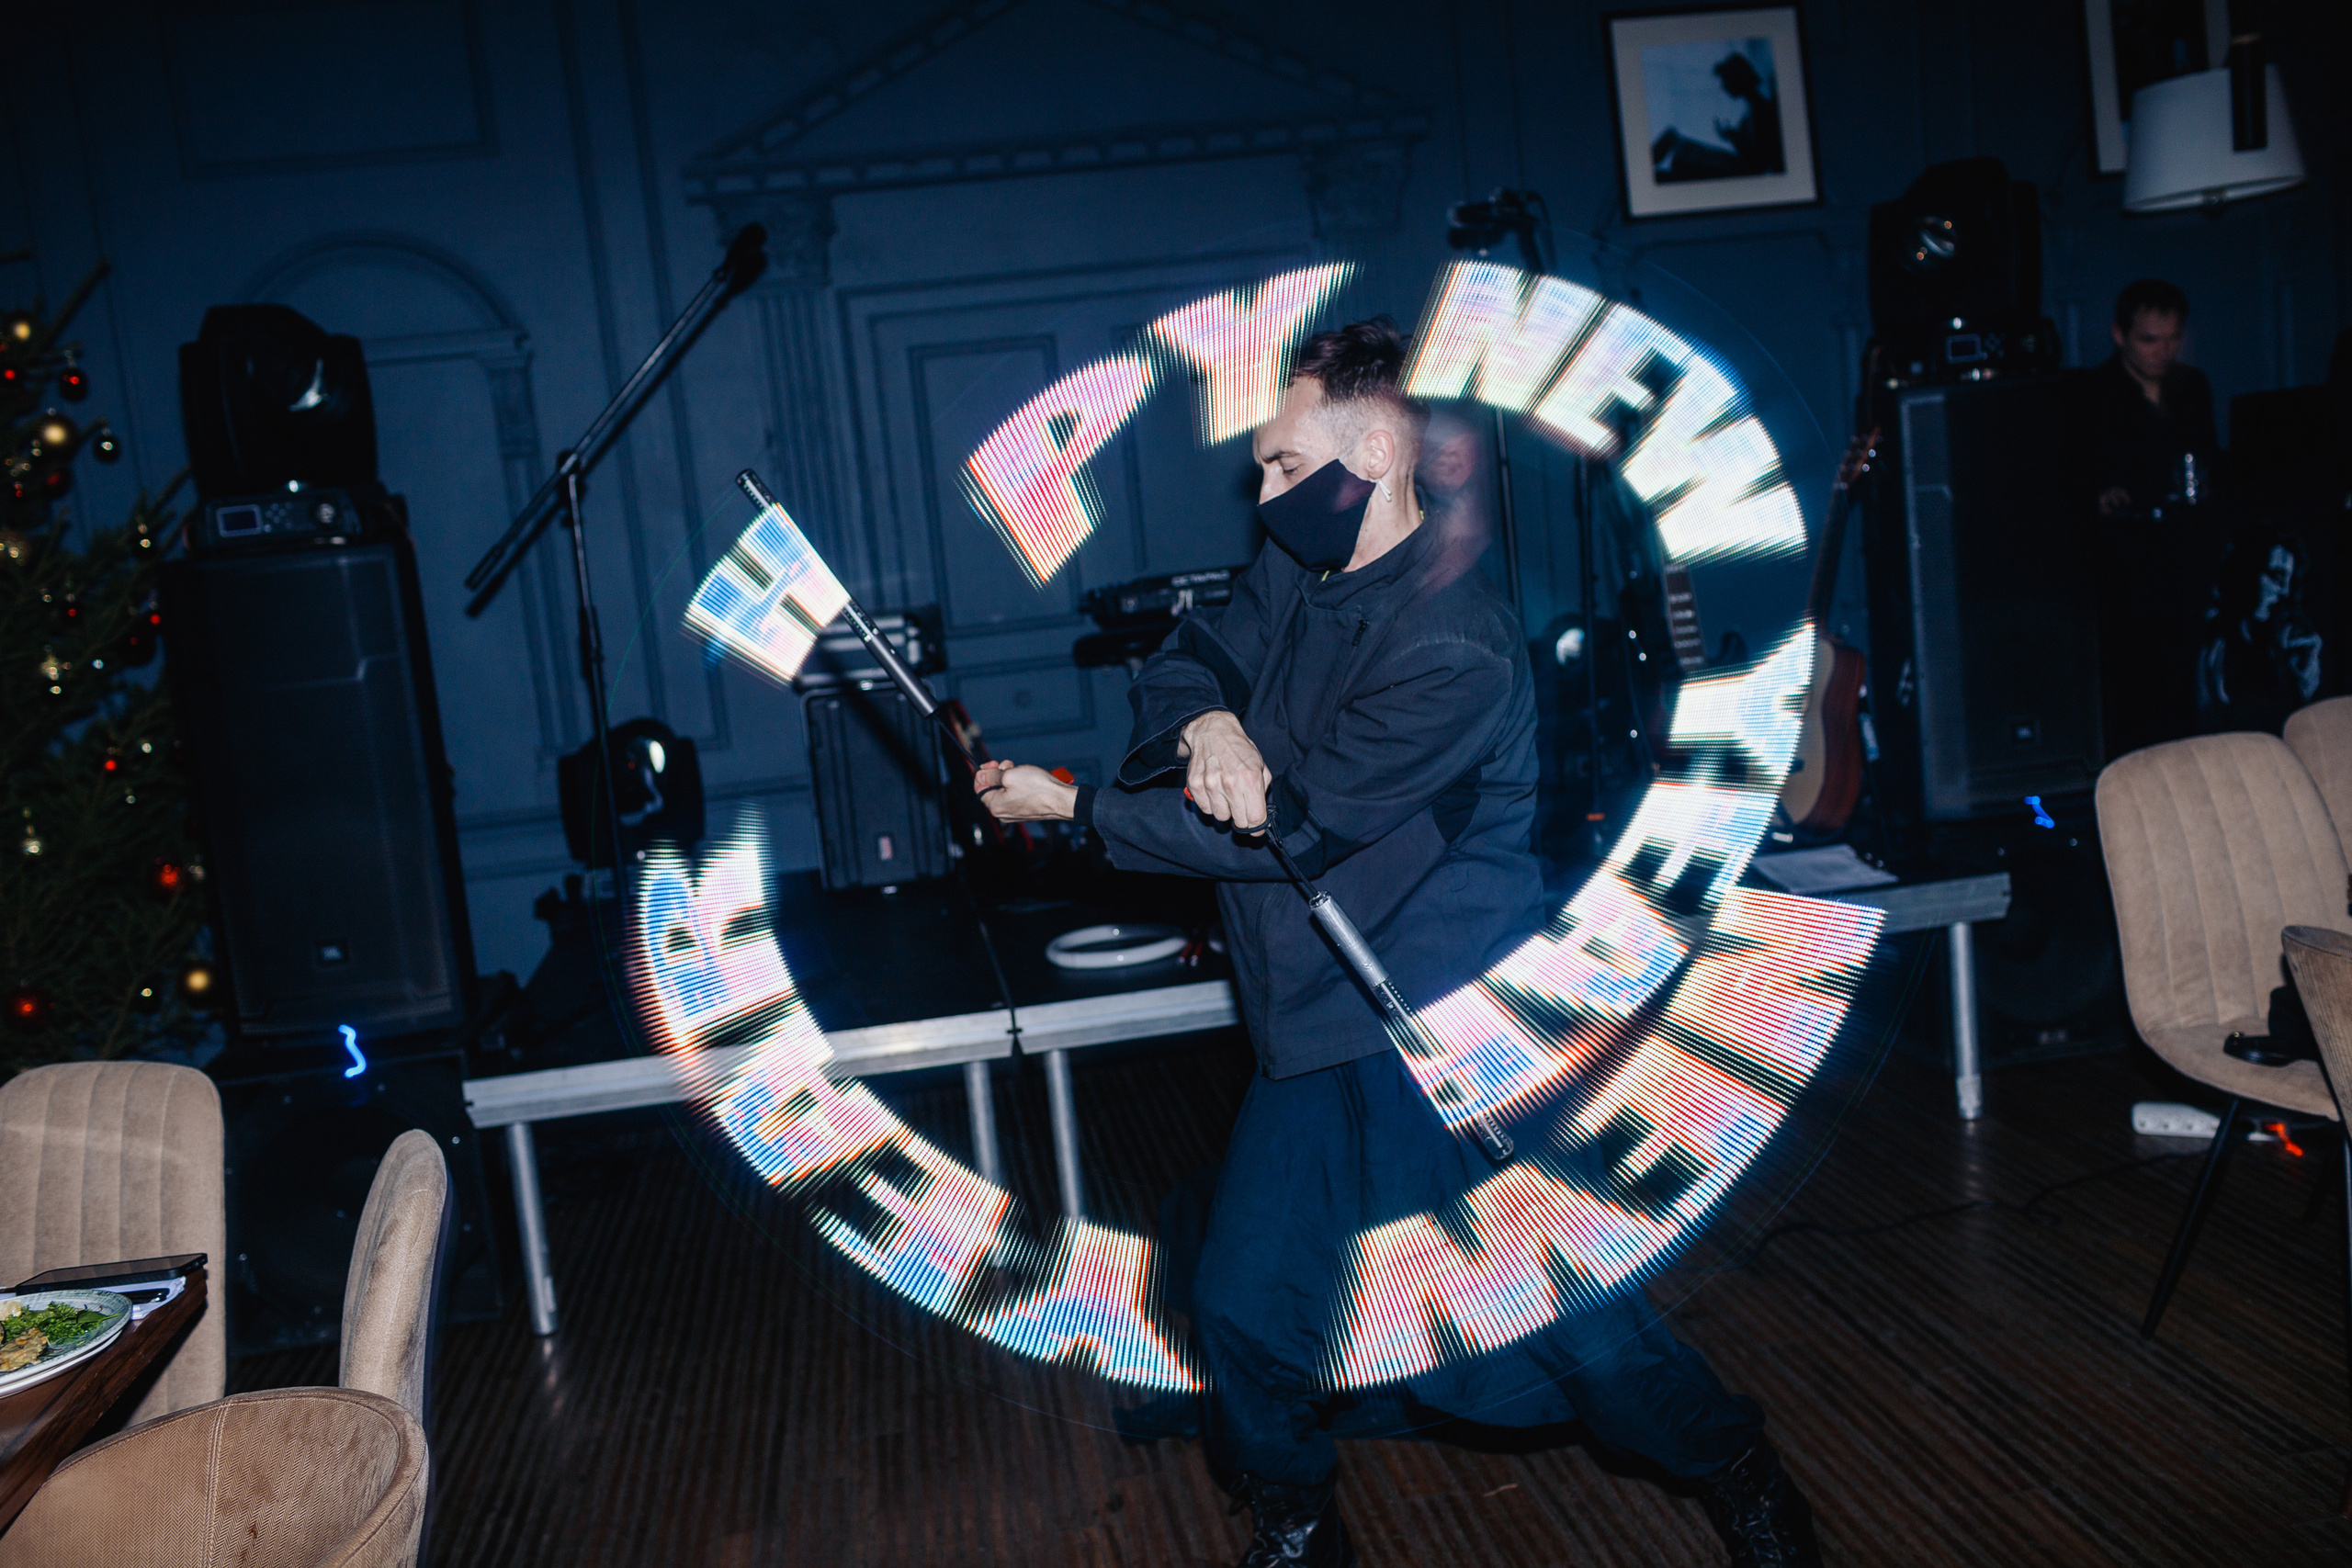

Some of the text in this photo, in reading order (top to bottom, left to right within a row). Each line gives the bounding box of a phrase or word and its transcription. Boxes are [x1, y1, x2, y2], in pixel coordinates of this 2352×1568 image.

[1401, 259, 1808, 558] NEW
[628, 818, 1204, 1392] YEAR
[1396, 617, 1817, 1141] YEAR
[1323, 886, 1887, 1392] NEW
